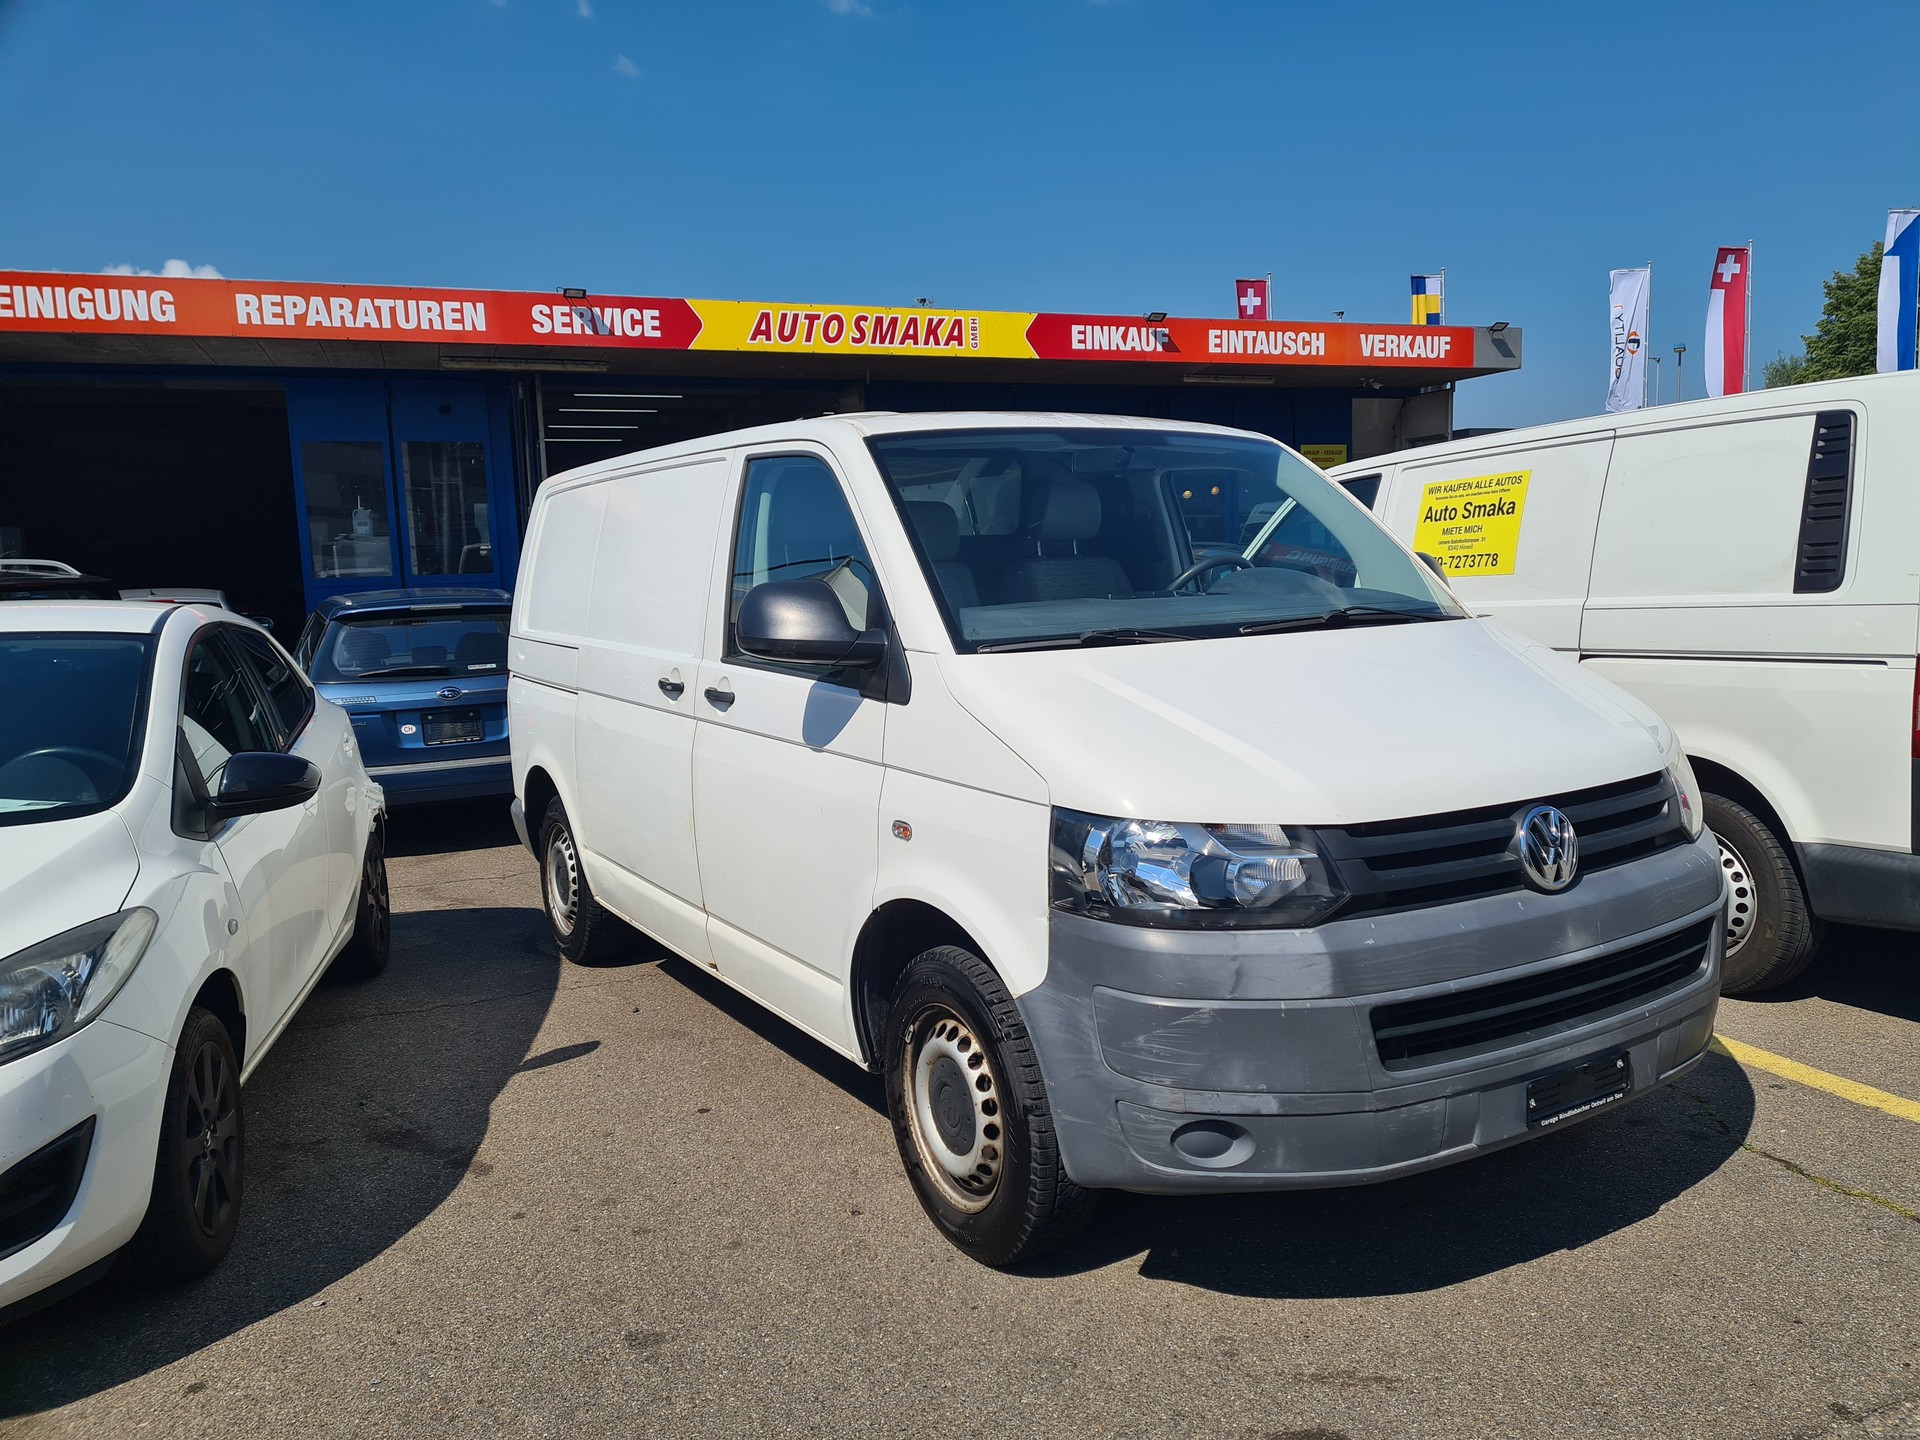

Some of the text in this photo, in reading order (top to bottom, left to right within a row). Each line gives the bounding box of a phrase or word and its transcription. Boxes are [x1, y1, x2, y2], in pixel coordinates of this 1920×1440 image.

[235, 293, 487, 331] REPARATUREN
[531, 304, 662, 338] SERVICE
[748, 311, 979, 349] AUTO SMAKA GMBH
[1071, 324, 1169, 352] EINKAUF
[1208, 329, 1325, 356] EINTAUSCH
[1359, 333, 1451, 359] VERKAUF
[1428, 475, 1523, 495] WIR KAUFEN ALLE AUTOS
[1423, 497, 1516, 523] Auto Smaka
[1441, 524, 1483, 536] MIETE MICH
[1434, 552, 1499, 570] 9-7273778
[1541, 1116, 1559, 1127] Garage
[1614, 1092, 1624, 1100] See
